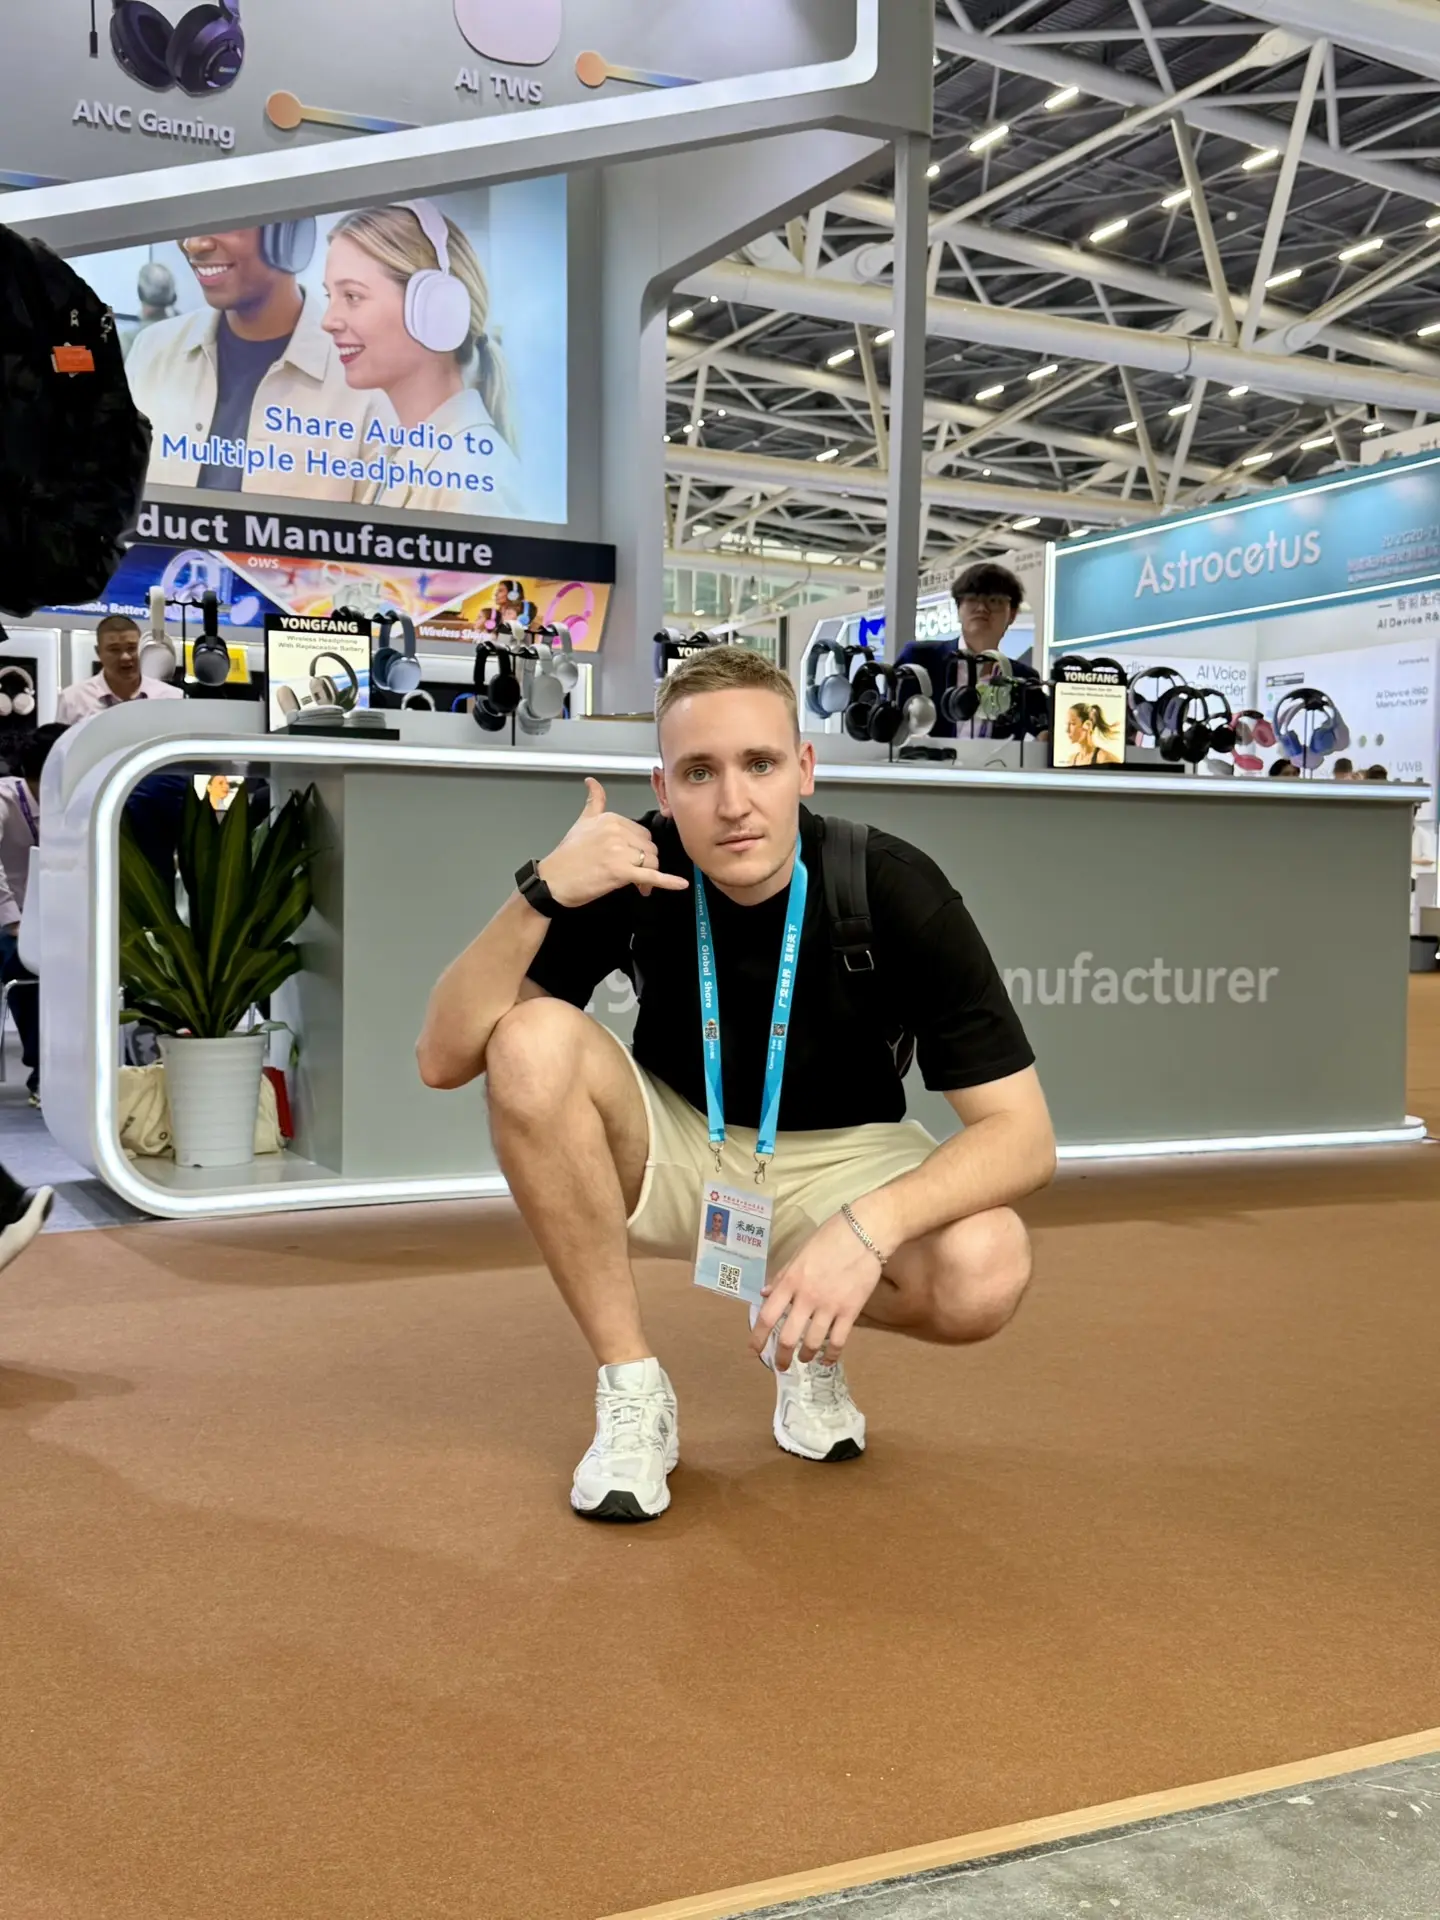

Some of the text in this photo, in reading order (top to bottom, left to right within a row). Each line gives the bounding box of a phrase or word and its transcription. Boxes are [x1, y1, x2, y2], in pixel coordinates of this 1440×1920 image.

[454, 67, 543, 103] AI TWS
[72, 99, 235, 149] ANC Gaming
[265, 406, 494, 456] Share Audio to
[162, 433, 494, 493] Multiple Headphones
[136, 504, 493, 567] duct Manufacture
[248, 556, 279, 569] OWS
[1135, 530, 1322, 598] Astrocetus
[280, 617, 358, 633] YONGFANG
[1389, 615, 1422, 628] Device
[1064, 671, 1119, 684] YONGFANG
[1196, 665, 1247, 680] AI Voice
[699, 921, 707, 940] Fair
[701, 944, 712, 976] Global
[1003, 951, 1280, 1005] nufacturer
[704, 980, 713, 1008] Share
[736, 1220, 765, 1238] 采购商
[736, 1233, 762, 1248] BUYER
